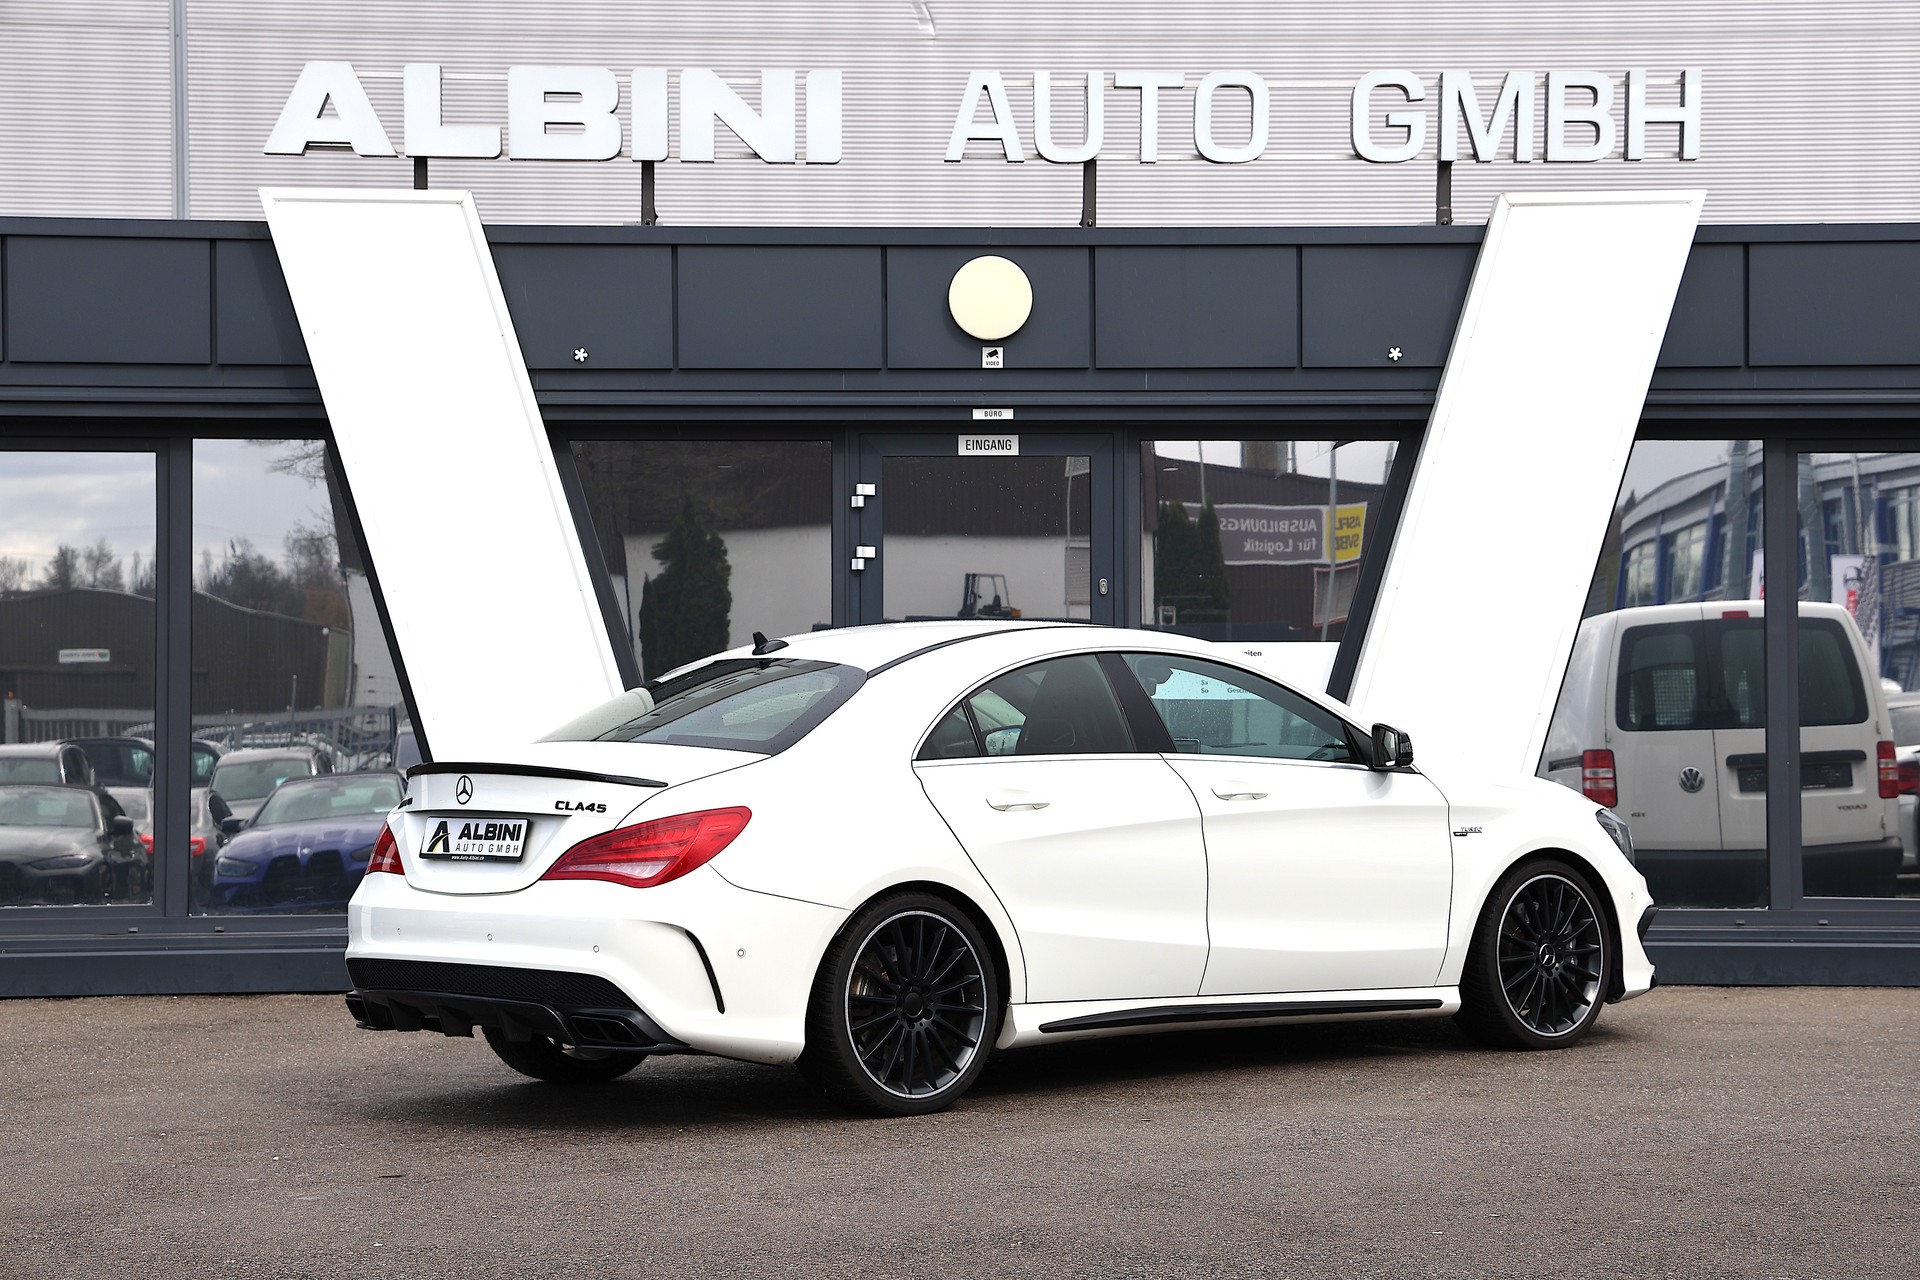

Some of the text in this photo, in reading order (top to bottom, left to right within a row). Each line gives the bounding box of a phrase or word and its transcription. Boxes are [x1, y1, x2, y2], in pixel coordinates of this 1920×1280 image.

[263, 60, 1702, 164] ALBINI AUTO GMBH
[984, 410, 1003, 418] BÜRO
[965, 439, 1012, 451] EINGANG
[554, 800, 607, 813] CLA45
[457, 822, 523, 842] ALBINI
[455, 843, 519, 854] AUTO GMBH
